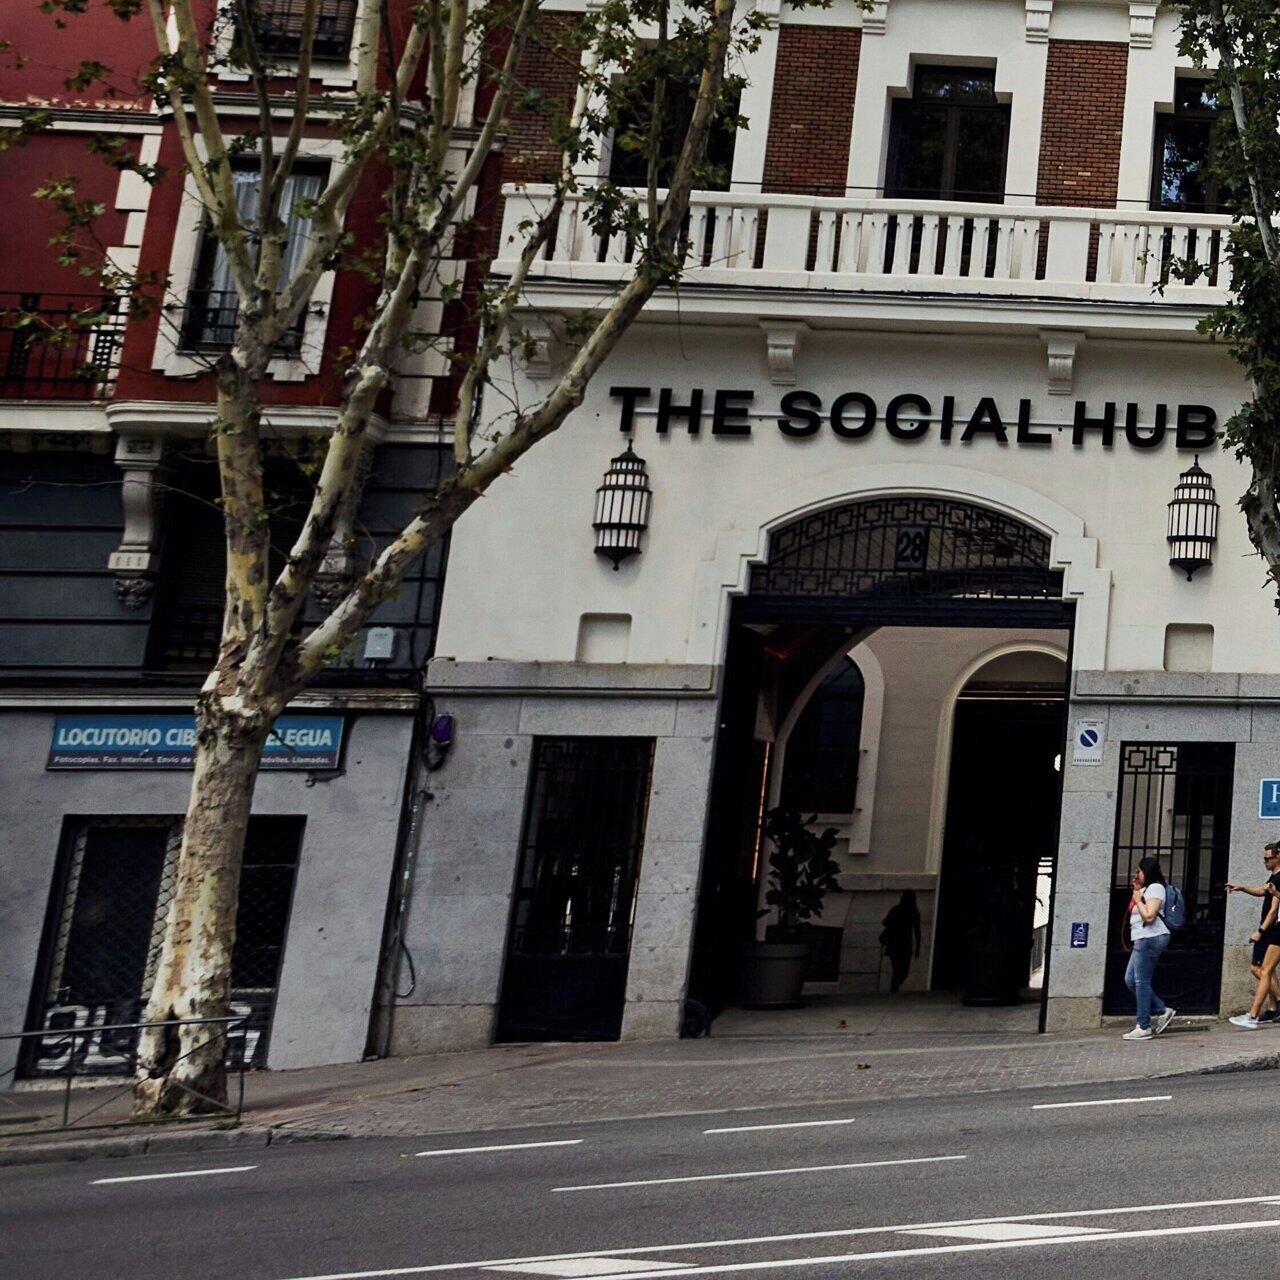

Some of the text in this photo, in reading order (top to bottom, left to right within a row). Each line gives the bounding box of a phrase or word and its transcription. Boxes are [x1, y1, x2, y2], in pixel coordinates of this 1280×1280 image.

[609, 386, 1217, 448] THE SOCIAL HUB
[898, 531, 924, 563] 28
[57, 727, 162, 746] LOCUTORIO
[164, 728, 197, 747] CIB
